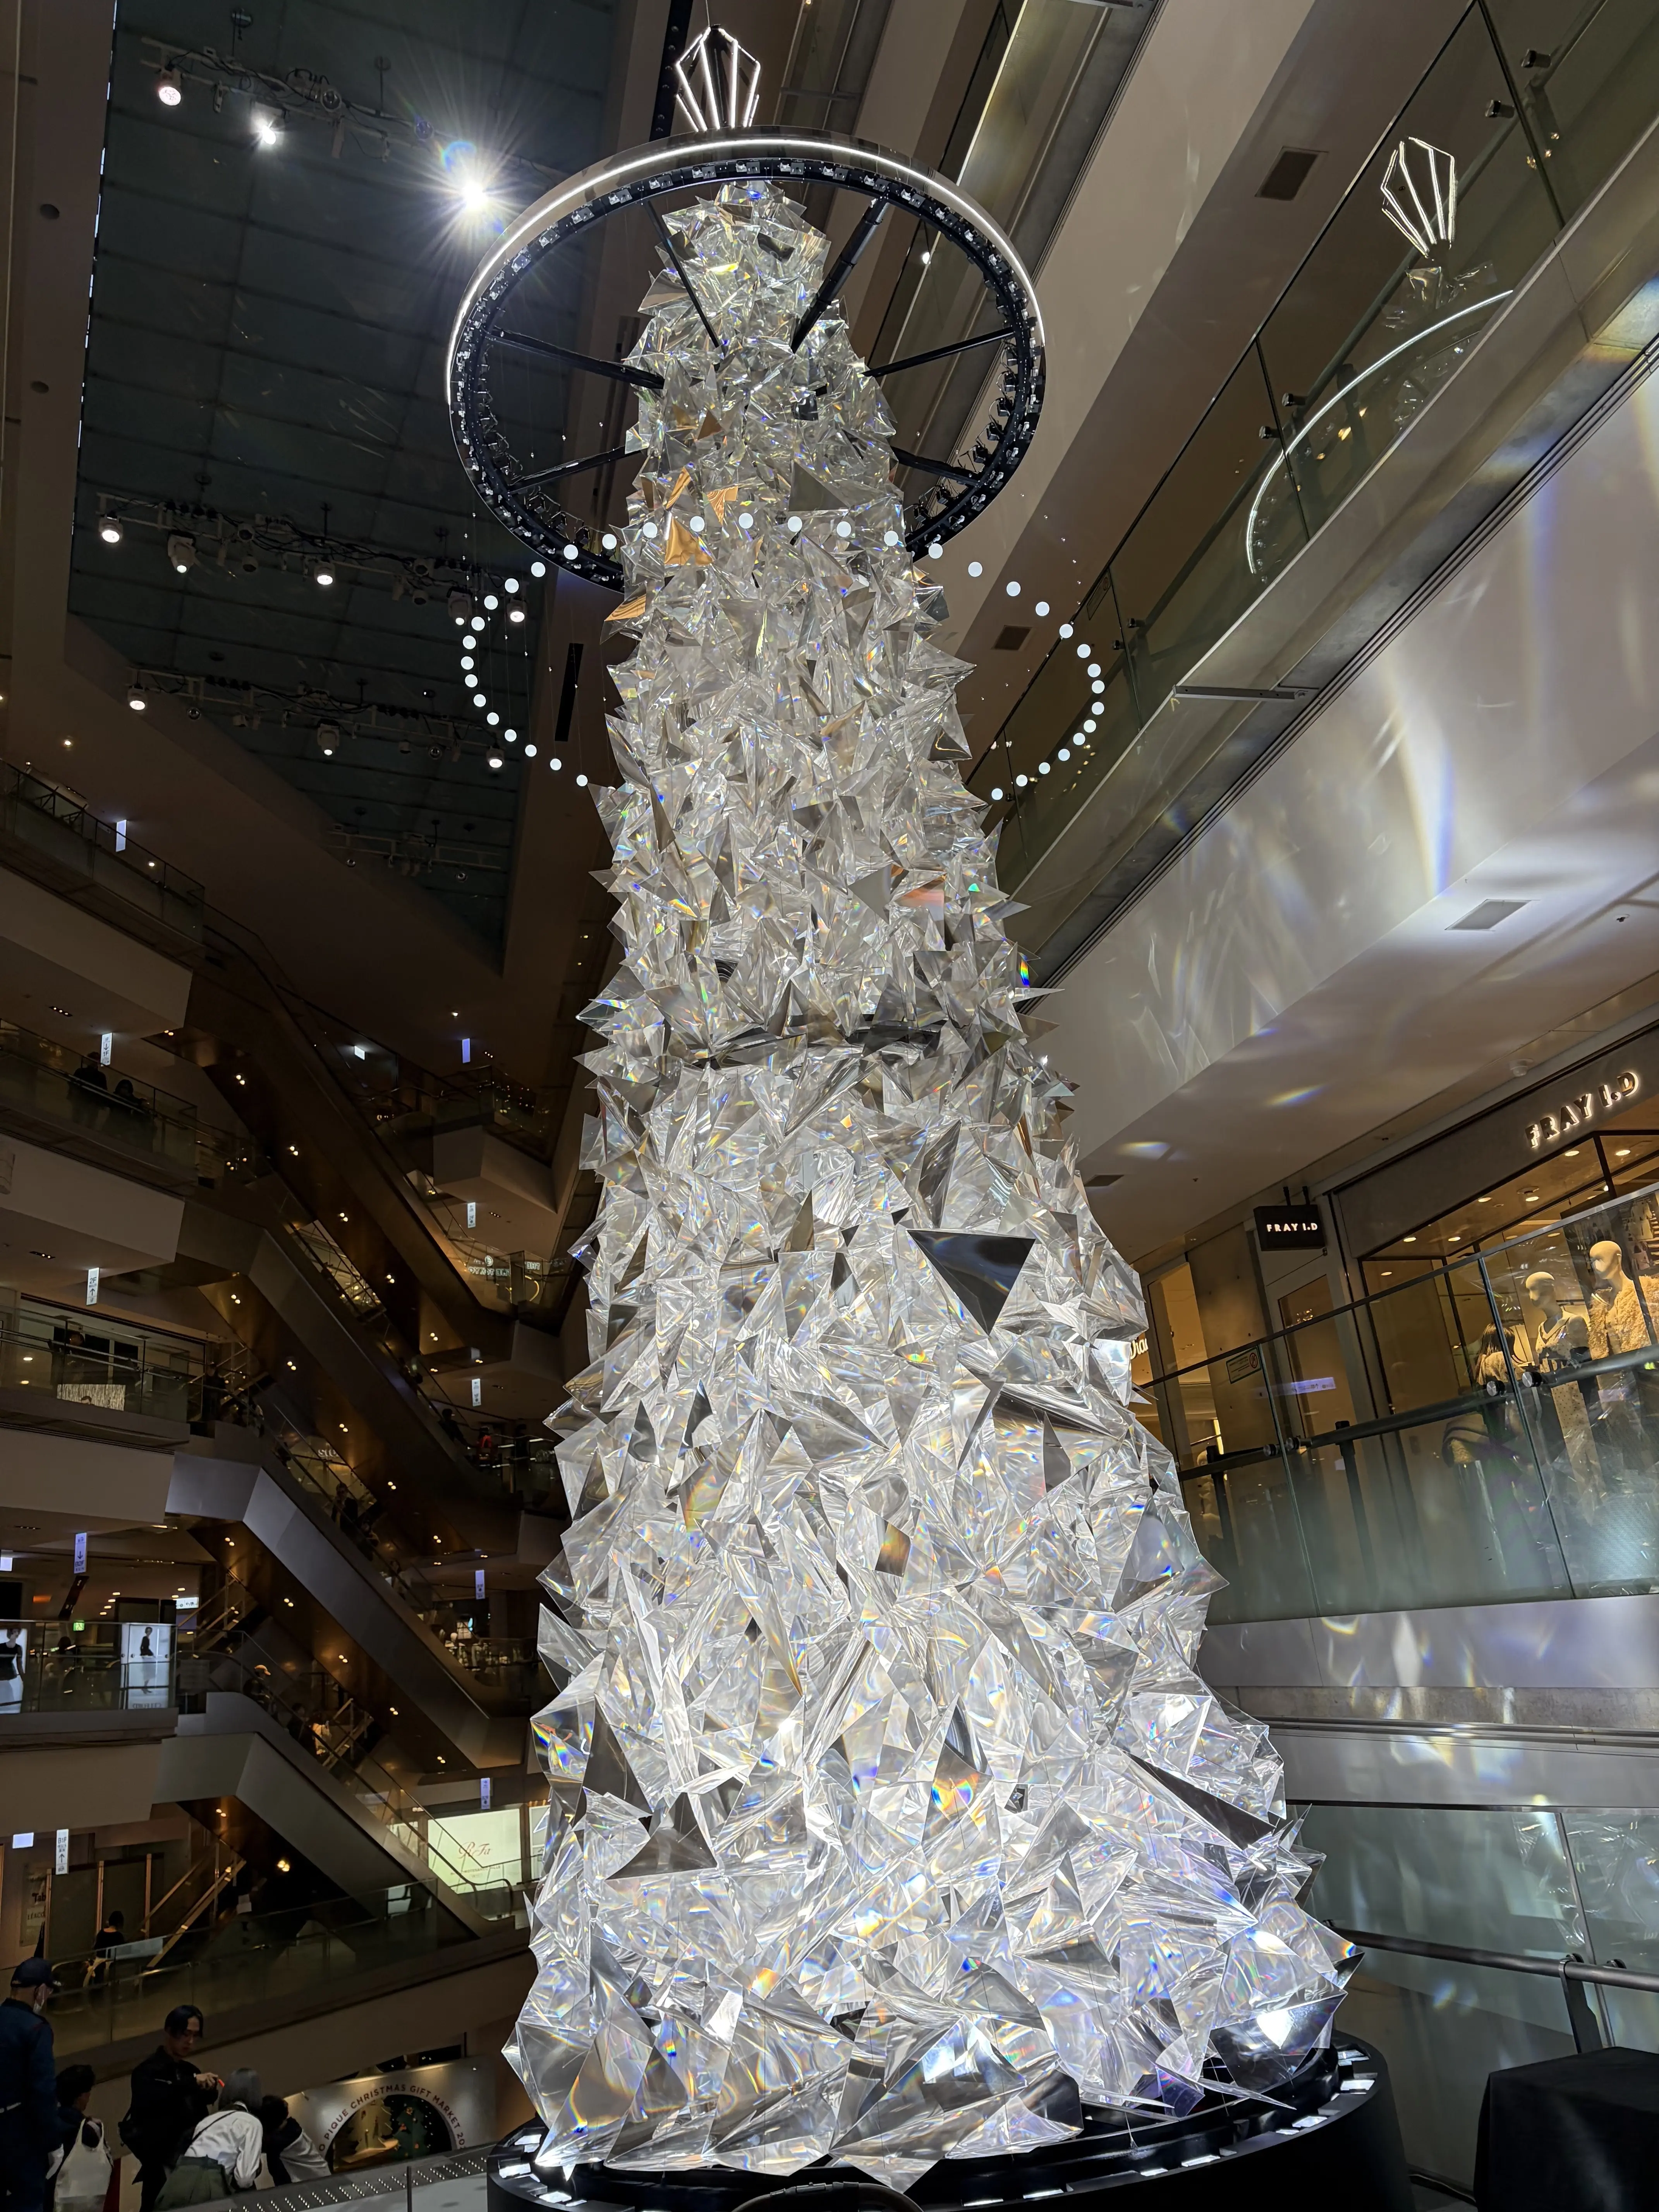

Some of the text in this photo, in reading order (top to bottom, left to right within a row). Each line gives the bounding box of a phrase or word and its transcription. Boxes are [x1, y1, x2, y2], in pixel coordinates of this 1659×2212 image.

[1525, 1072, 1639, 1148] FRAY I.D
[1267, 1223, 1317, 1232] FRAY I.D
[324, 2108, 349, 2140] PIQUE
[350, 2084, 406, 2109] CHRISTMAS
[410, 2085, 432, 2098] GIFT
[433, 2095, 461, 2129] MARKET
